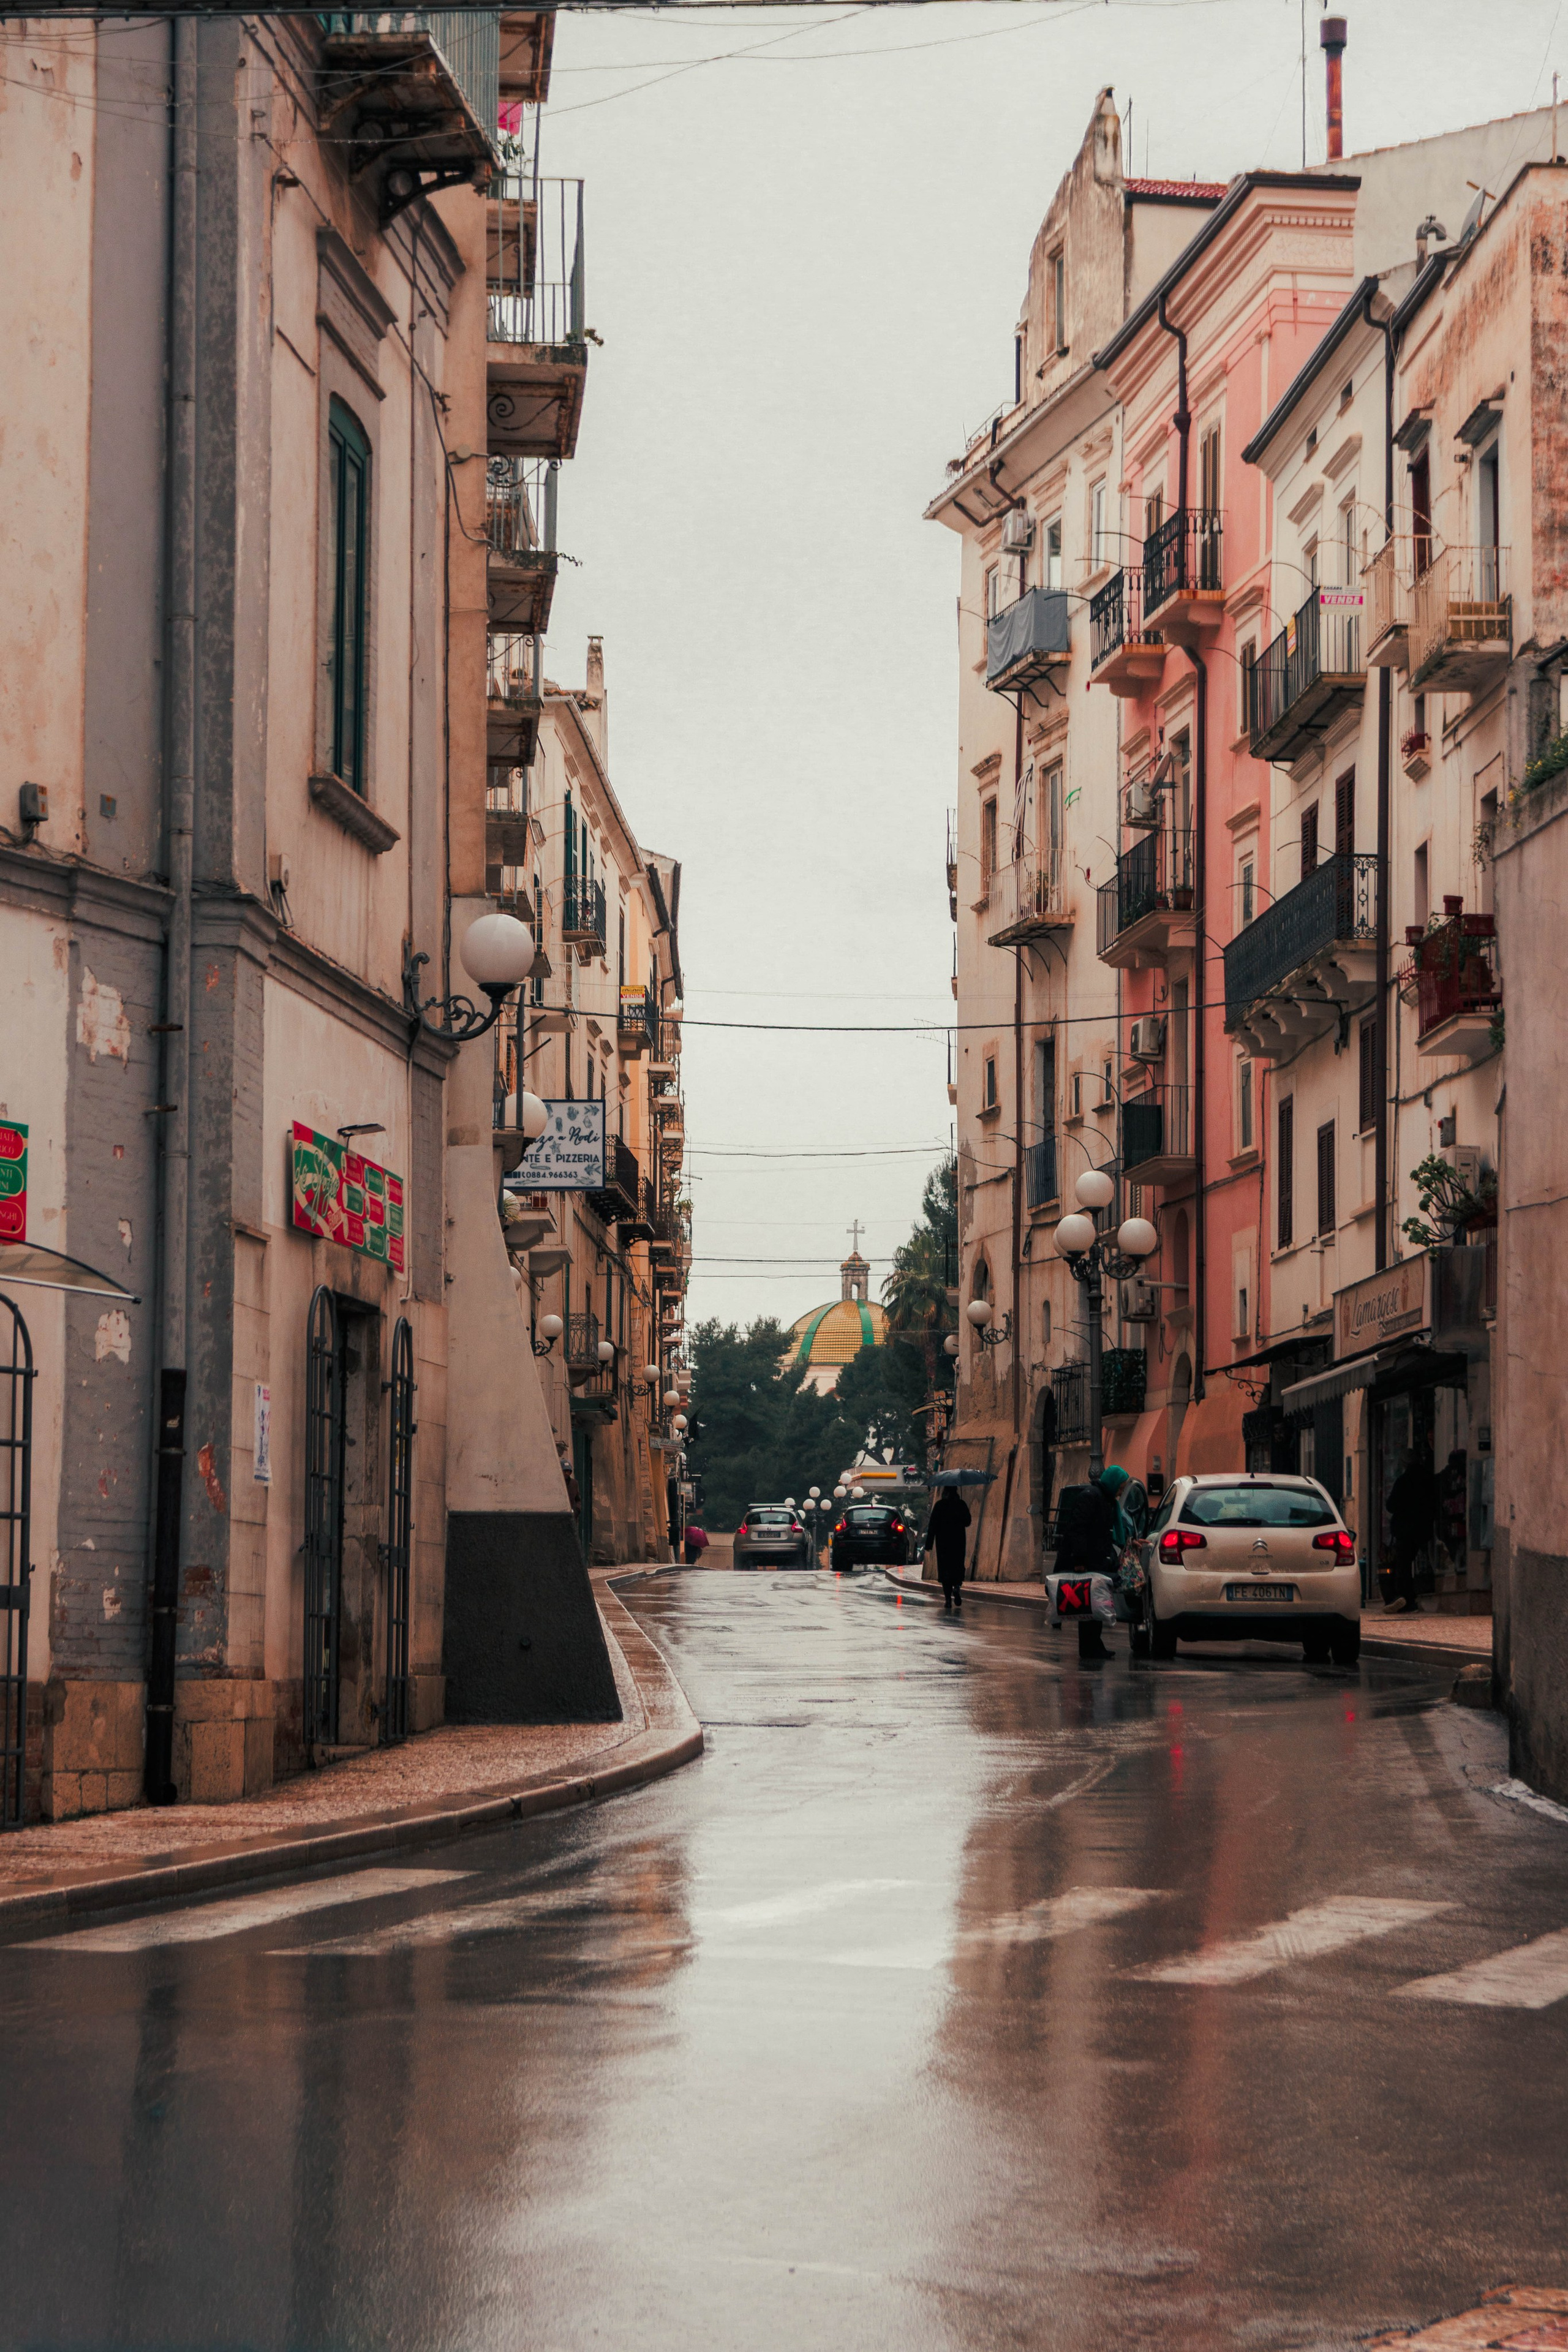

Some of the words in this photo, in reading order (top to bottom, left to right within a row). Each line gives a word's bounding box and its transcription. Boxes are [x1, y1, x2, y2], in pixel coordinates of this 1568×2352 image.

[1324, 595, 1360, 605] VENDE
[569, 1126, 600, 1145] Rodi
[545, 1154, 551, 1163] E
[556, 1154, 600, 1163] PIZZERIA
[1234, 1586, 1247, 1598] FE
[1252, 1586, 1286, 1598] 406TN
